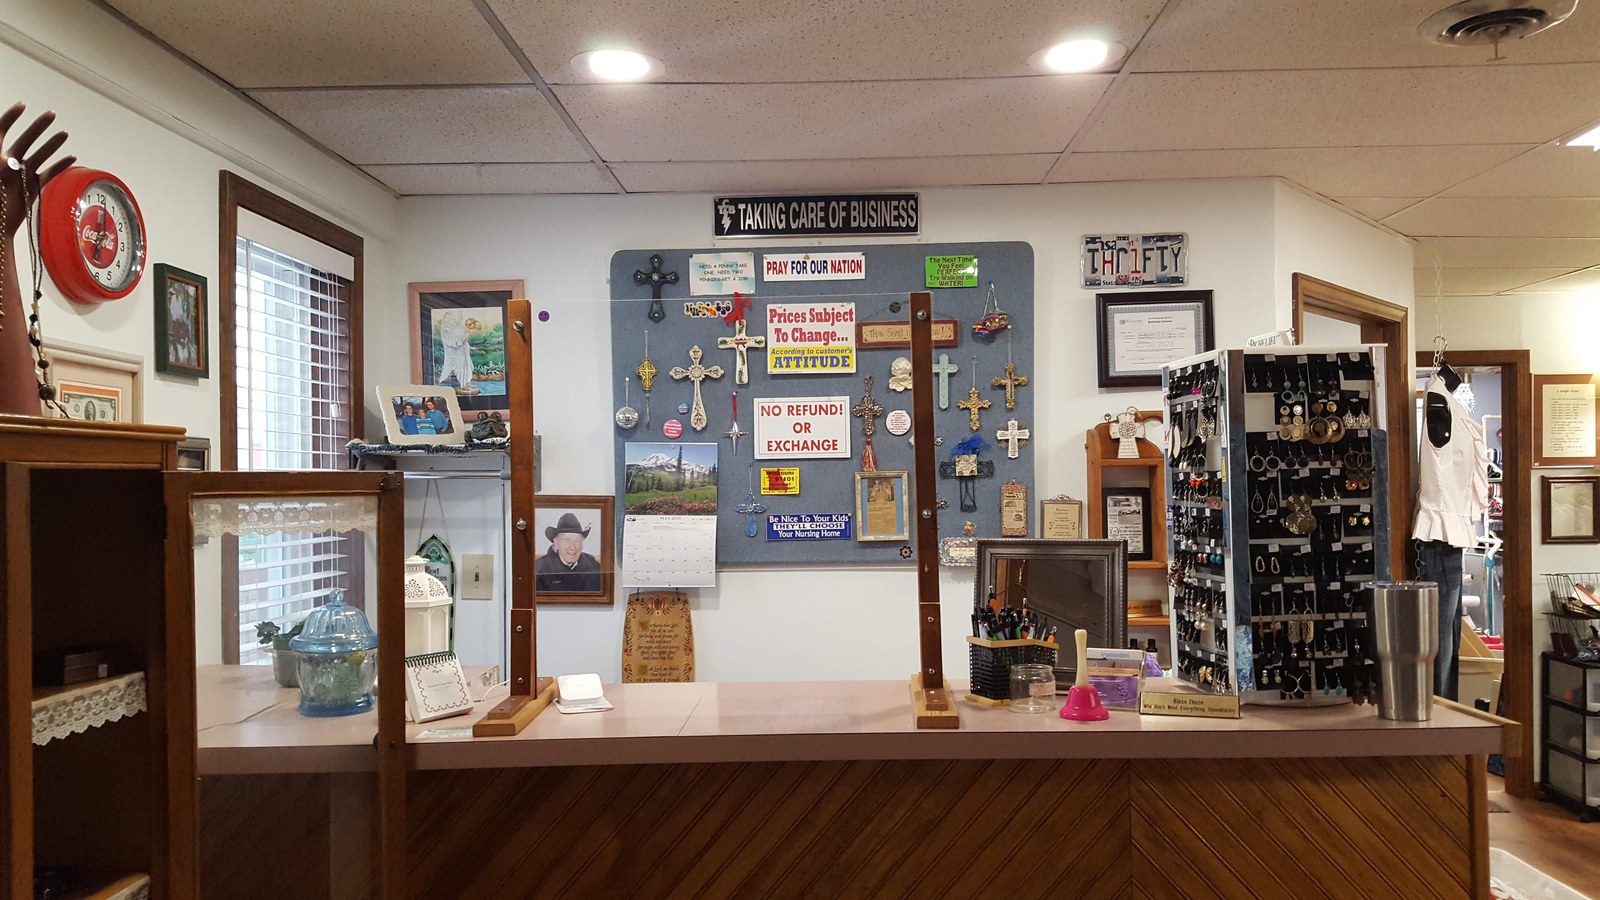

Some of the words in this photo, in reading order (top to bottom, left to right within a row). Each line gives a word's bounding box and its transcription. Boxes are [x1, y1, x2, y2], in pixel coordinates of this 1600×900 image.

[97, 194, 106, 205] 12
[737, 202, 786, 230] TAKING
[789, 201, 826, 229] CARE
[828, 201, 848, 229] OF
[850, 199, 917, 228] BUSINESS
[82, 224, 115, 250] Cocaola
[120, 242, 125, 252] 3
[116, 260, 121, 269] 4
[766, 261, 789, 275] PRAY
[791, 260, 808, 275] FOR
[810, 260, 828, 274] OUR
[831, 259, 863, 274] NATION
[107, 271, 112, 281] 5
[769, 308, 807, 323] Prices
[809, 307, 854, 327] Subject
[774, 328, 789, 343] To
[791, 327, 849, 346] Change...
[771, 348, 806, 356] According
[773, 355, 850, 369] ATTITUDE
[760, 405, 782, 417] NO
[787, 404, 843, 416] REFUND!
[793, 422, 812, 434] OR
[767, 439, 838, 452] EXCHANGE
[781, 515, 798, 523] Nice
[832, 514, 849, 522] Kids
[778, 530, 793, 538] Your
[795, 530, 820, 538] Nursing
[1179, 705, 1206, 713] Everything
